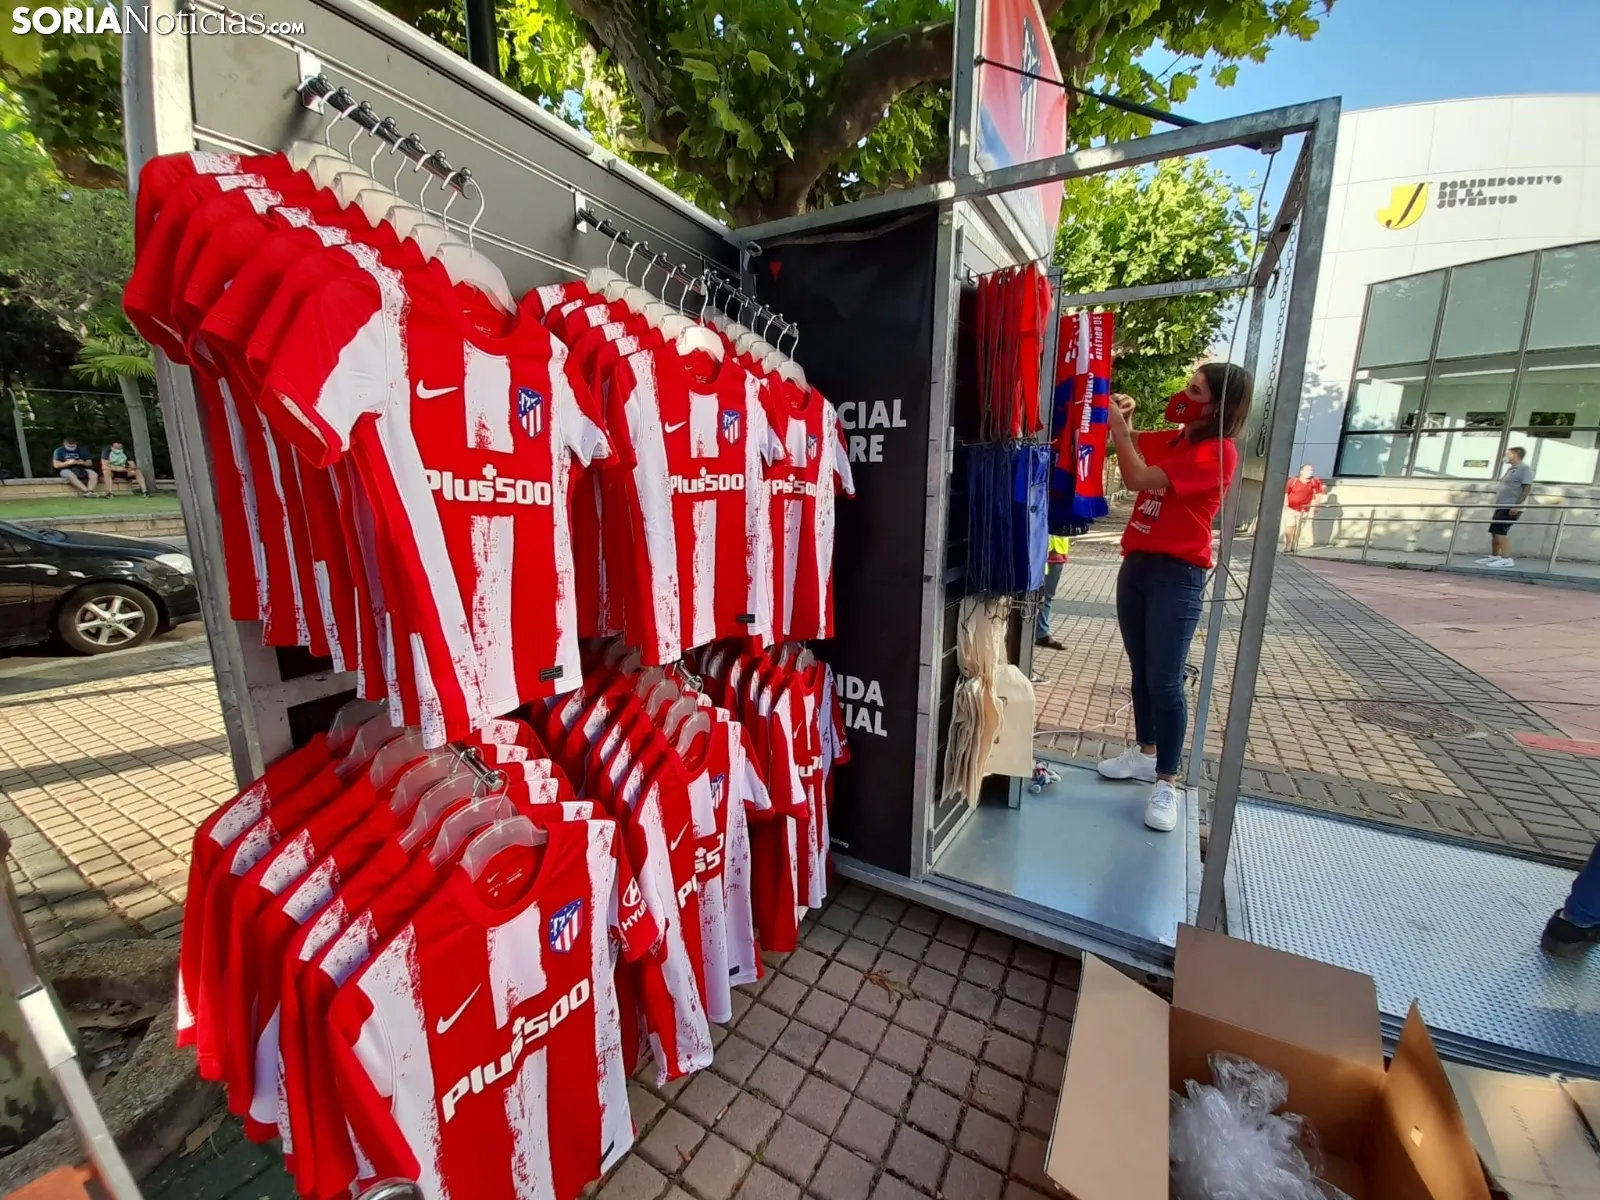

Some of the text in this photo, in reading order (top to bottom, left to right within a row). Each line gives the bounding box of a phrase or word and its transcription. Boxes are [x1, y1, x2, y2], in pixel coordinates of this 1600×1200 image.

[1438, 189, 1484, 200] DE LA
[1439, 175, 1562, 191] POLIDEPORTIVO
[1437, 195, 1517, 209] JUVENTUD
[837, 398, 907, 430] CIAL
[849, 434, 885, 463] RE
[423, 464, 551, 506] Plus500
[670, 467, 745, 496] Plus500
[442, 978, 590, 1123] Plus500
